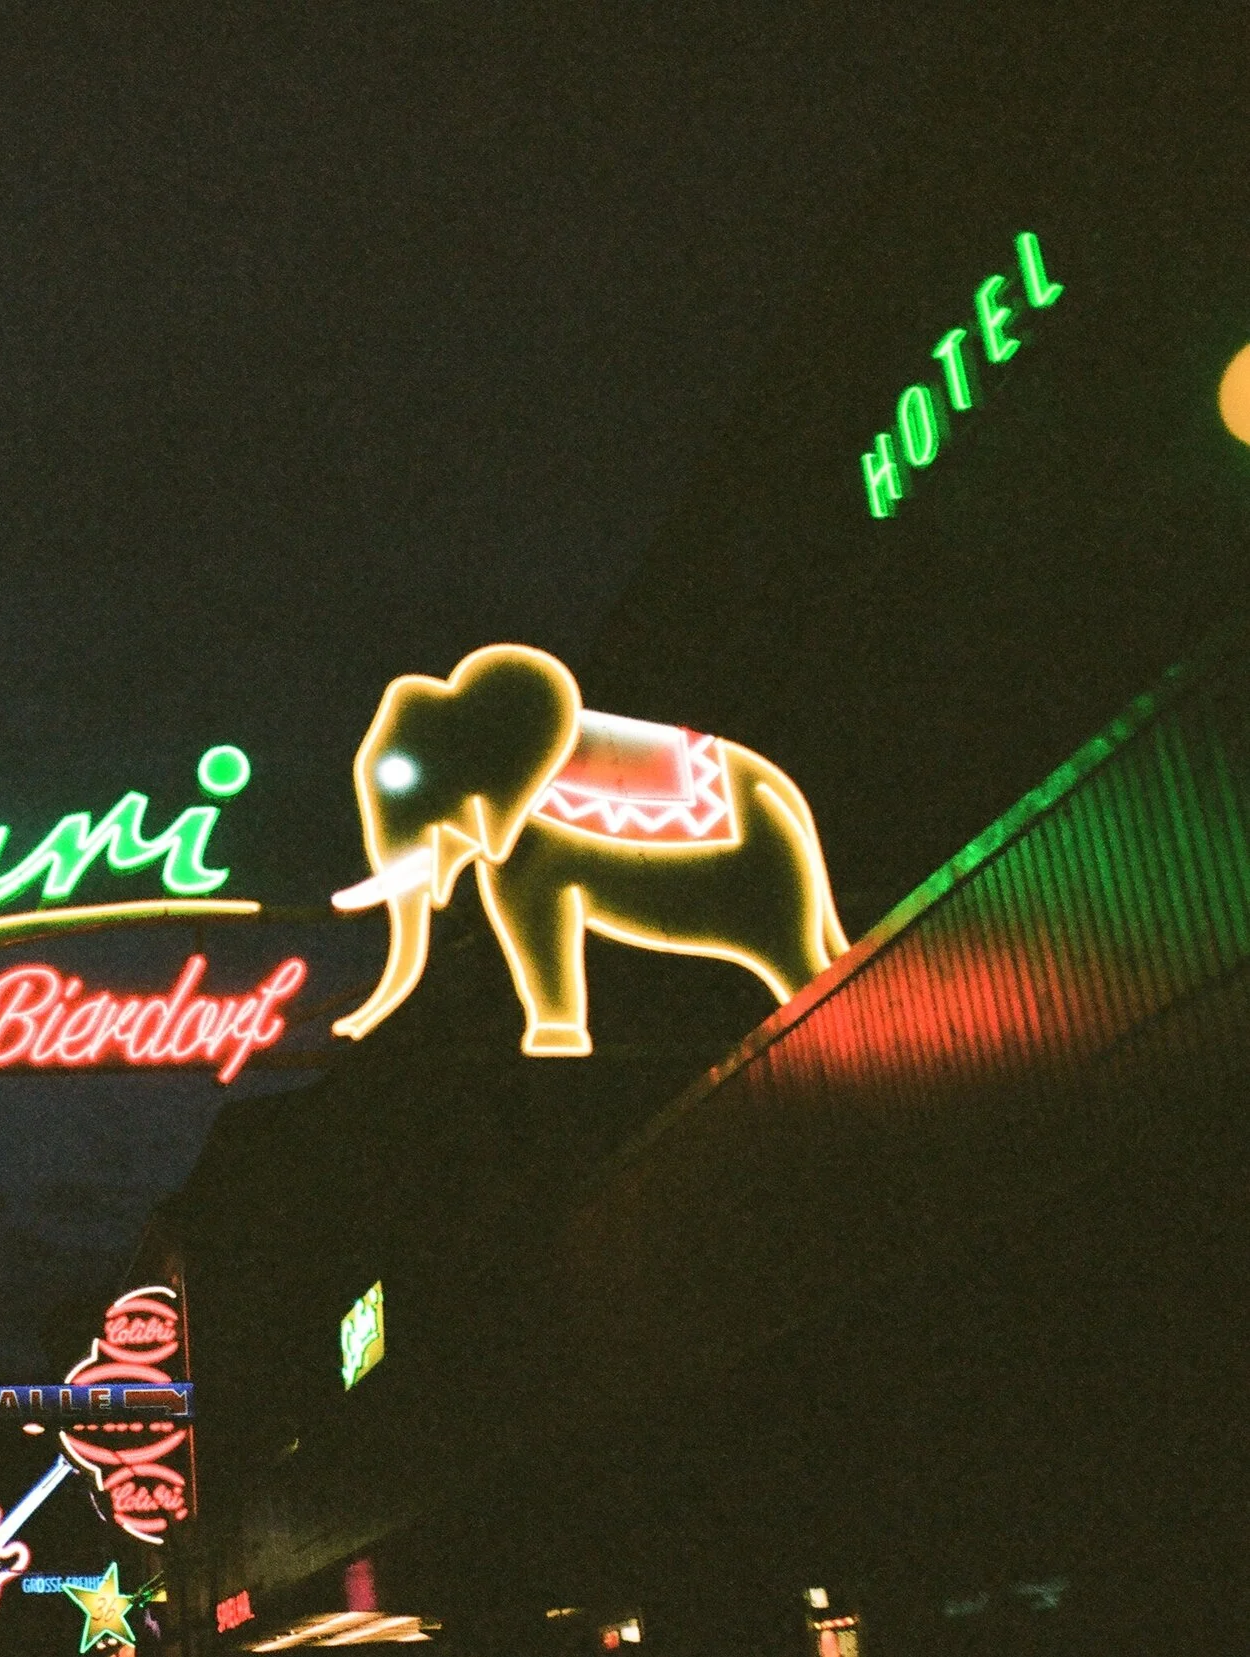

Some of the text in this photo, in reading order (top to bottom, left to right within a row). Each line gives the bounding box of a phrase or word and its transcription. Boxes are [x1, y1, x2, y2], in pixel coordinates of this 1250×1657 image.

[861, 232, 1065, 518] HOTEL
[22, 1576, 63, 1593] GROSSE
[91, 1597, 117, 1621] 36
